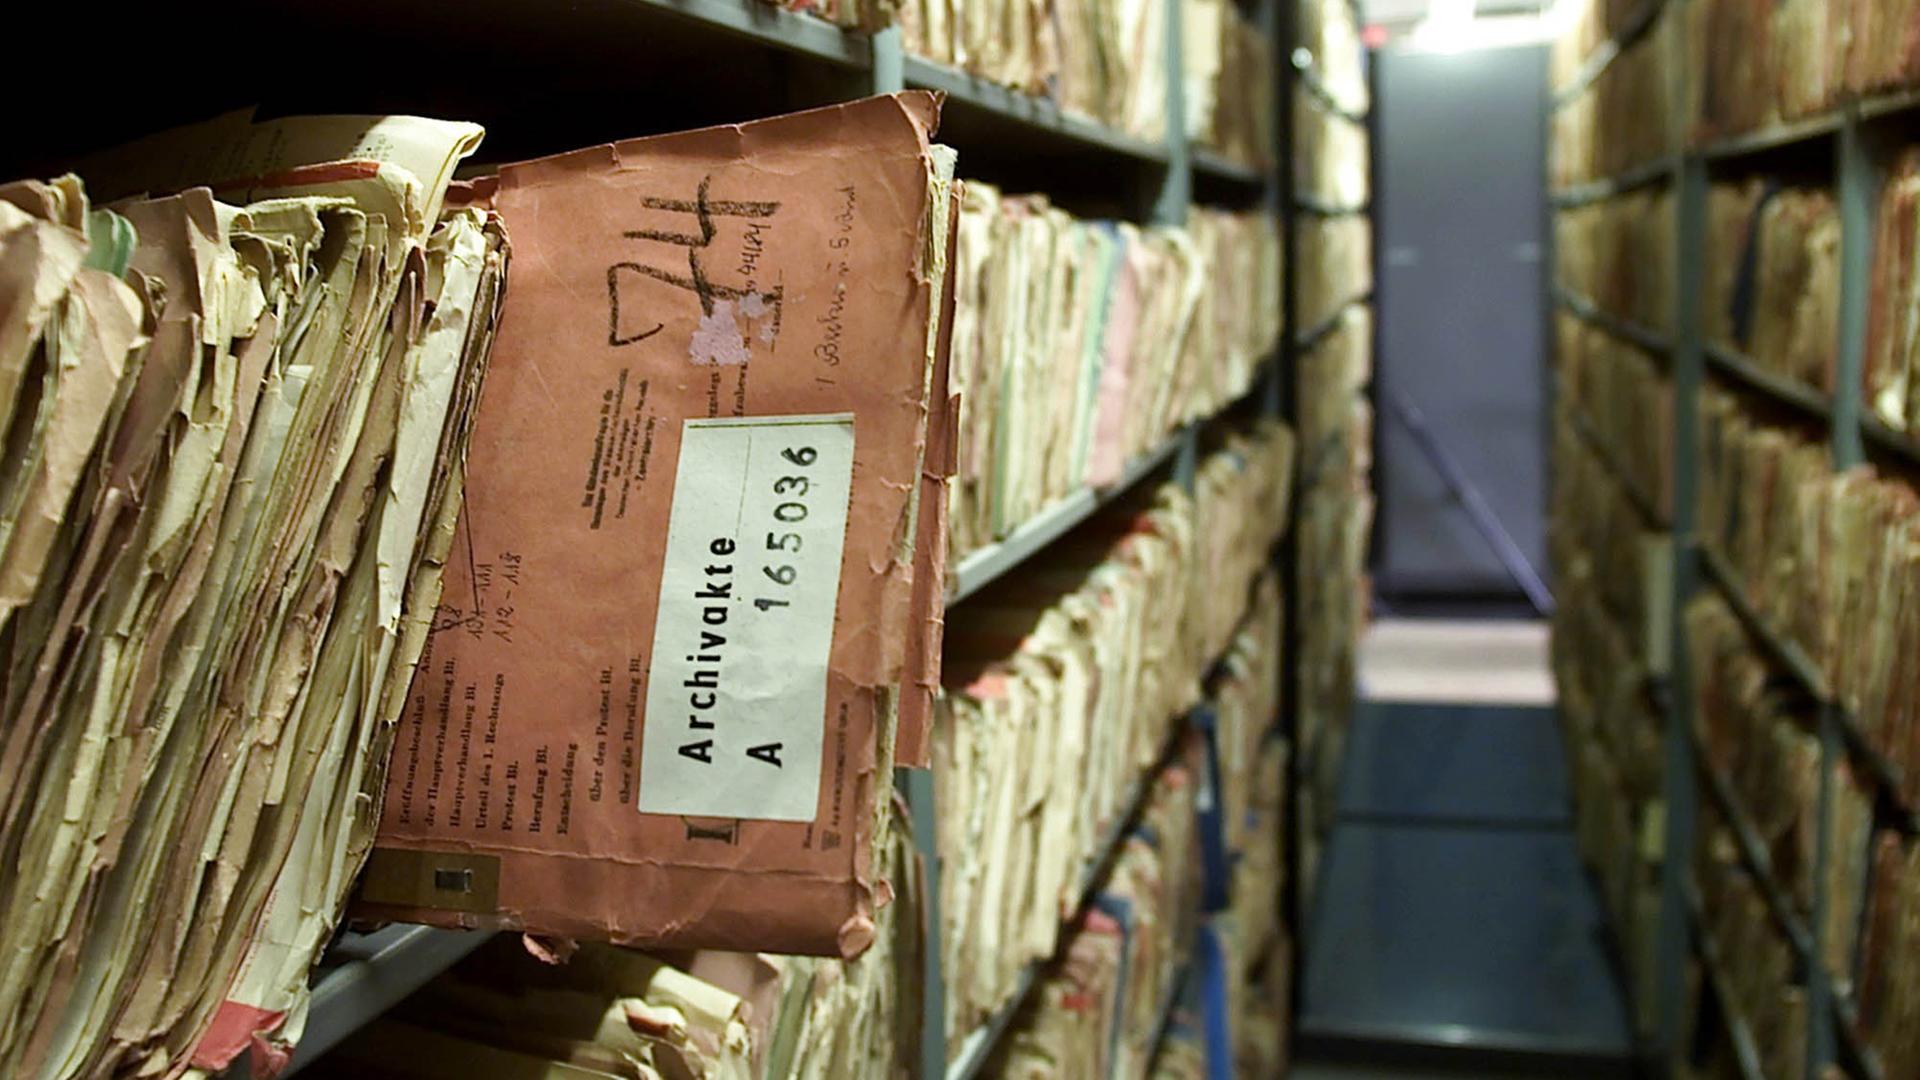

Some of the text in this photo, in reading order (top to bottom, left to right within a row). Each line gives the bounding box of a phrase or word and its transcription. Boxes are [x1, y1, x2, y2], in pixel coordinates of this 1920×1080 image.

[607, 174, 781, 346] 74
[745, 445, 818, 768] A 165036
[678, 536, 736, 764] Archivakte
[427, 679, 454, 801] Hauptverhandlung
[596, 689, 611, 736] Protest
[624, 676, 641, 741] Berufung
[449, 705, 475, 827] Hauptverhandlung
[480, 763, 492, 786] des
[593, 741, 606, 766] den
[475, 789, 488, 828] Urteil
[501, 783, 516, 831] Protest
[528, 768, 548, 833] Berufung
[556, 743, 578, 835] Entscheidung
